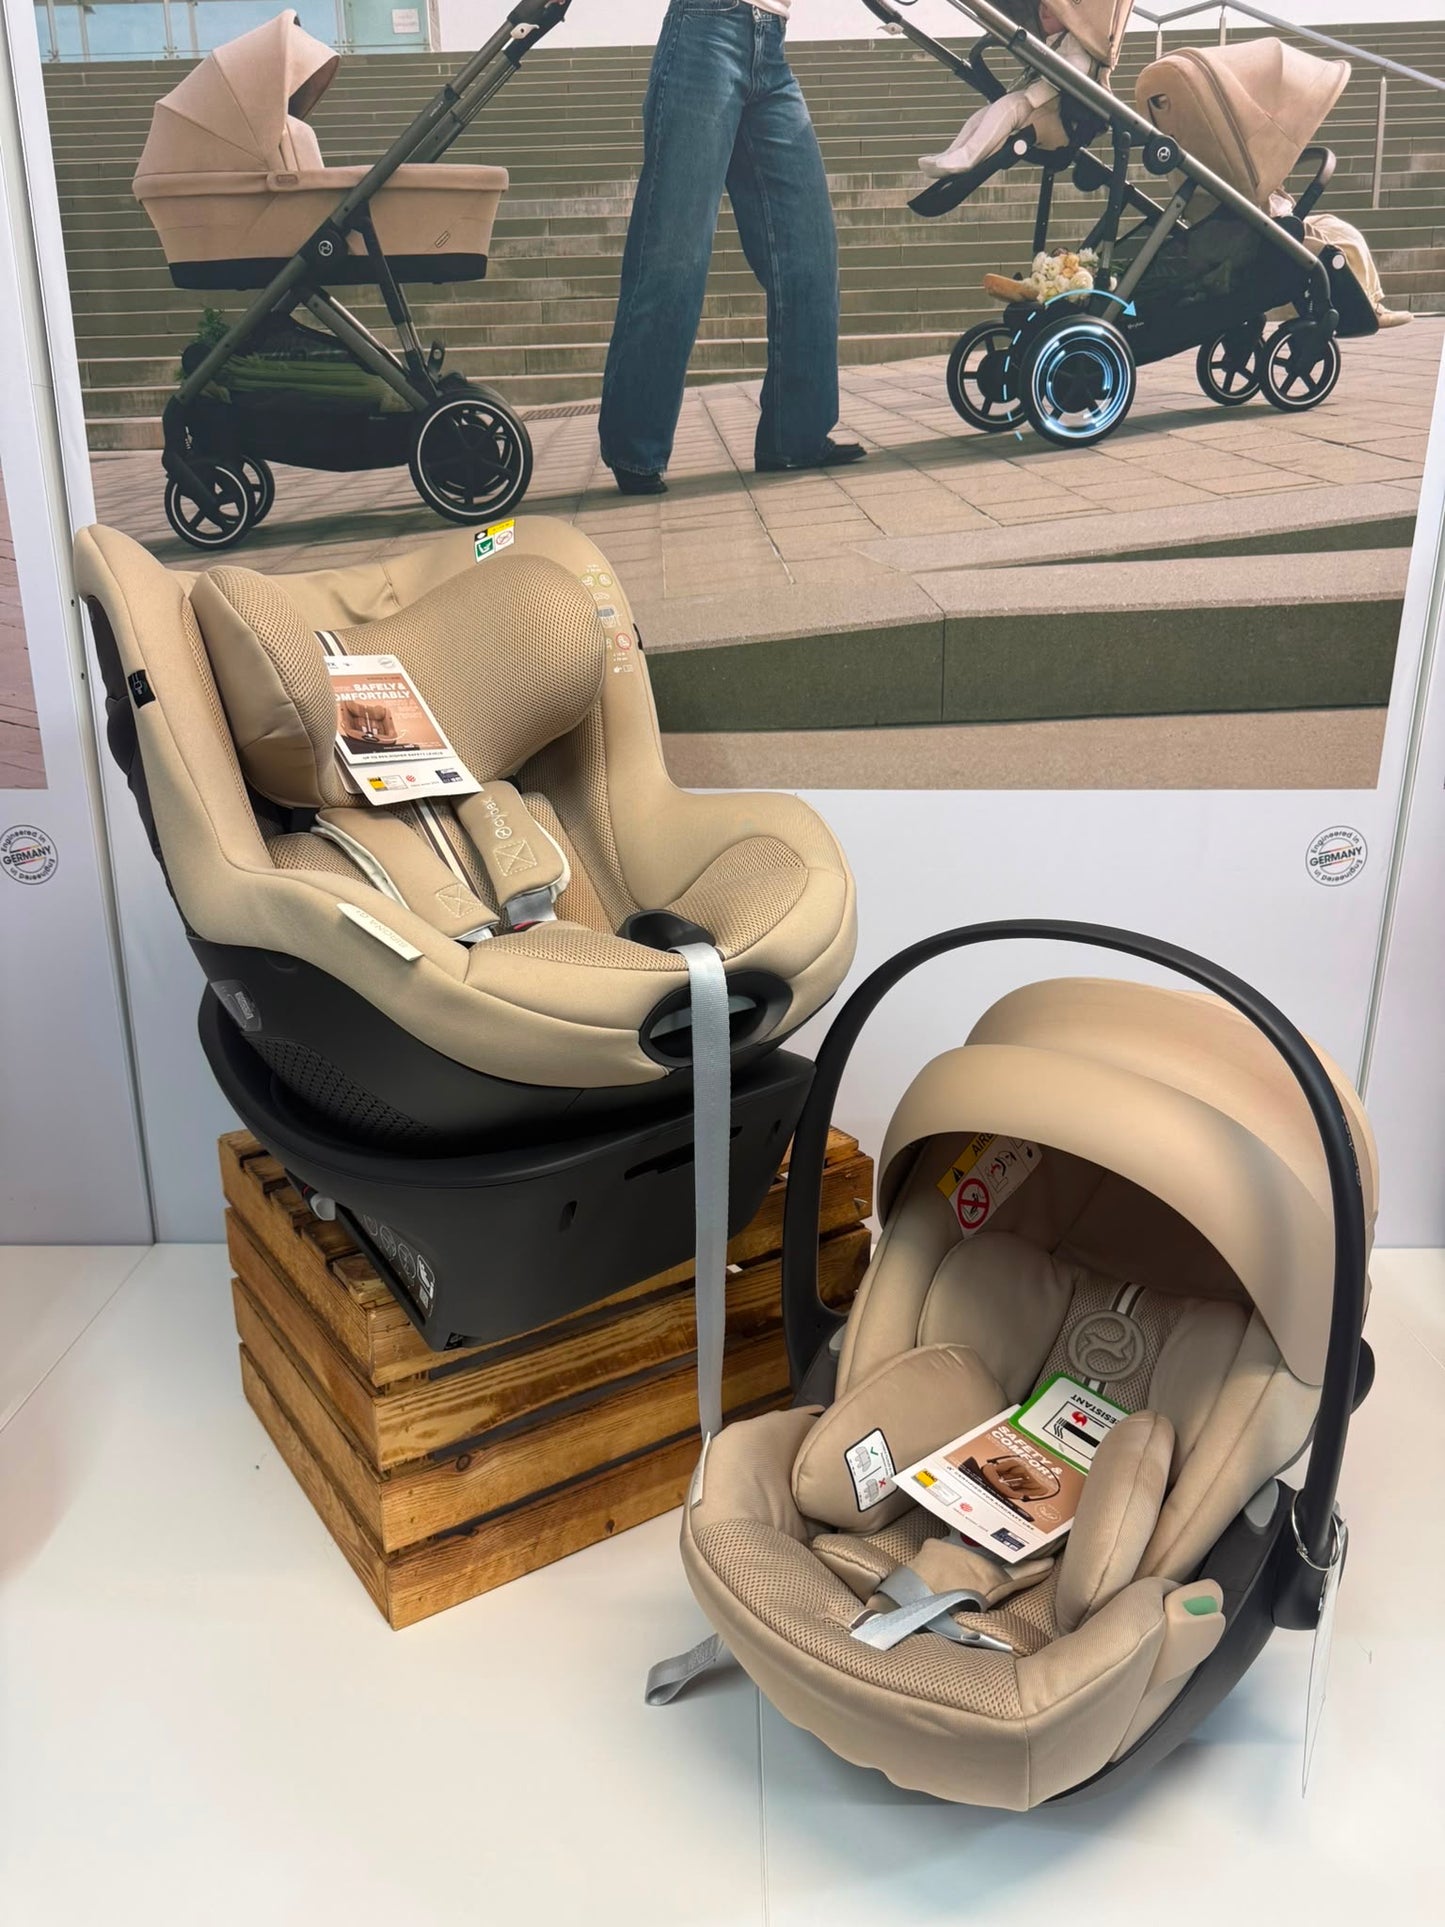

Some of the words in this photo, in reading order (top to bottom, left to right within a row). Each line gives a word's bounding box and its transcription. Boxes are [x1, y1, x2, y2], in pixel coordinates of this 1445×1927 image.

[334, 690, 411, 702] OMFORTABLY
[353, 682, 397, 692] SAFELY
[396, 682, 406, 690] &
[481, 797, 509, 827] cybex
[1, 830, 38, 852] Engineered
[38, 835, 46, 843] in
[1310, 830, 1353, 854] Engineered
[1352, 835, 1360, 844] in
[3, 845, 51, 865] GERMANY
[1309, 846, 1363, 867] GERMANY
[10, 867, 18, 876] in
[19, 858, 56, 881] Engineered
[1313, 869, 1322, 878] in
[1320, 859, 1363, 882] Engineered
[1069, 1393, 1119, 1426] ESISTANT
[990, 1429, 1057, 1480] COMFORT
[996, 1425, 1054, 1468] SAFETY
[1051, 1461, 1064, 1474] &
